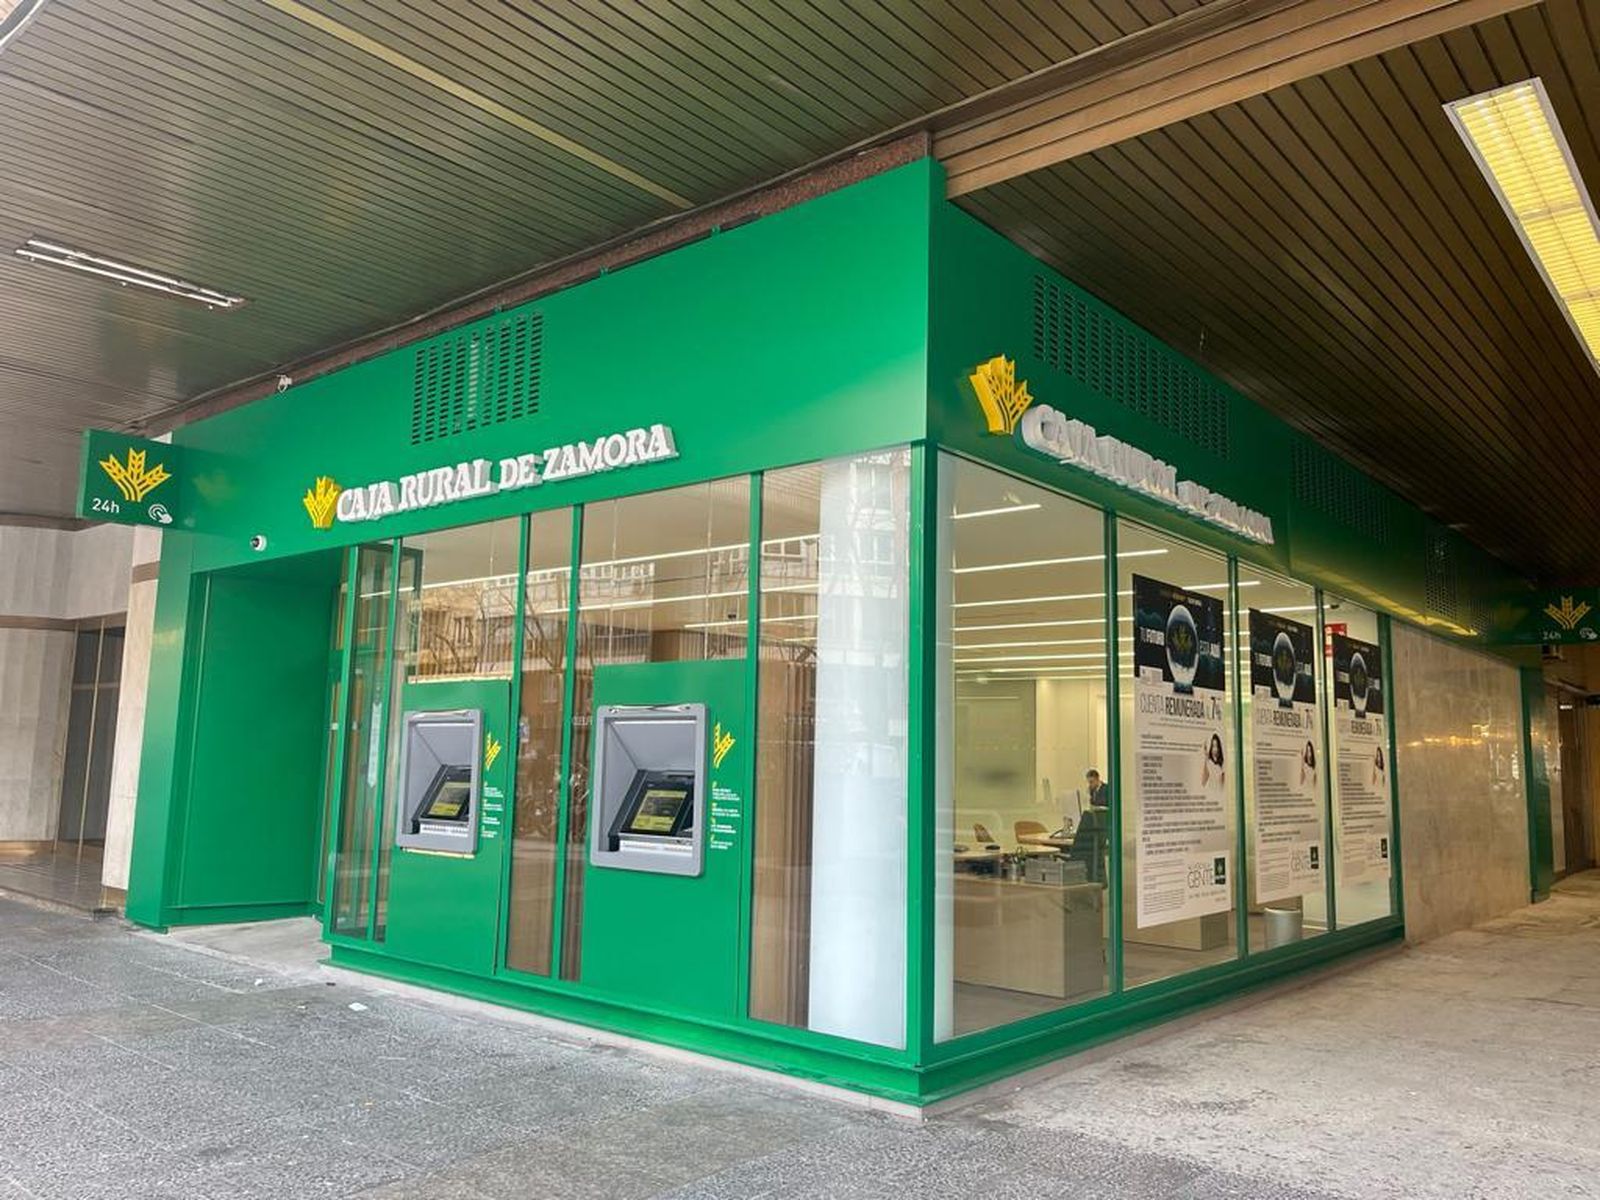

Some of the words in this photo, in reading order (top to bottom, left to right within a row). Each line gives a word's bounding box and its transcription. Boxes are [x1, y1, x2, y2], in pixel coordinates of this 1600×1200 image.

[336, 481, 400, 522] CAJA
[398, 458, 498, 511] RURAL
[499, 453, 543, 490] DE
[543, 423, 680, 481] ZAMORA
[92, 498, 120, 513] 24h
